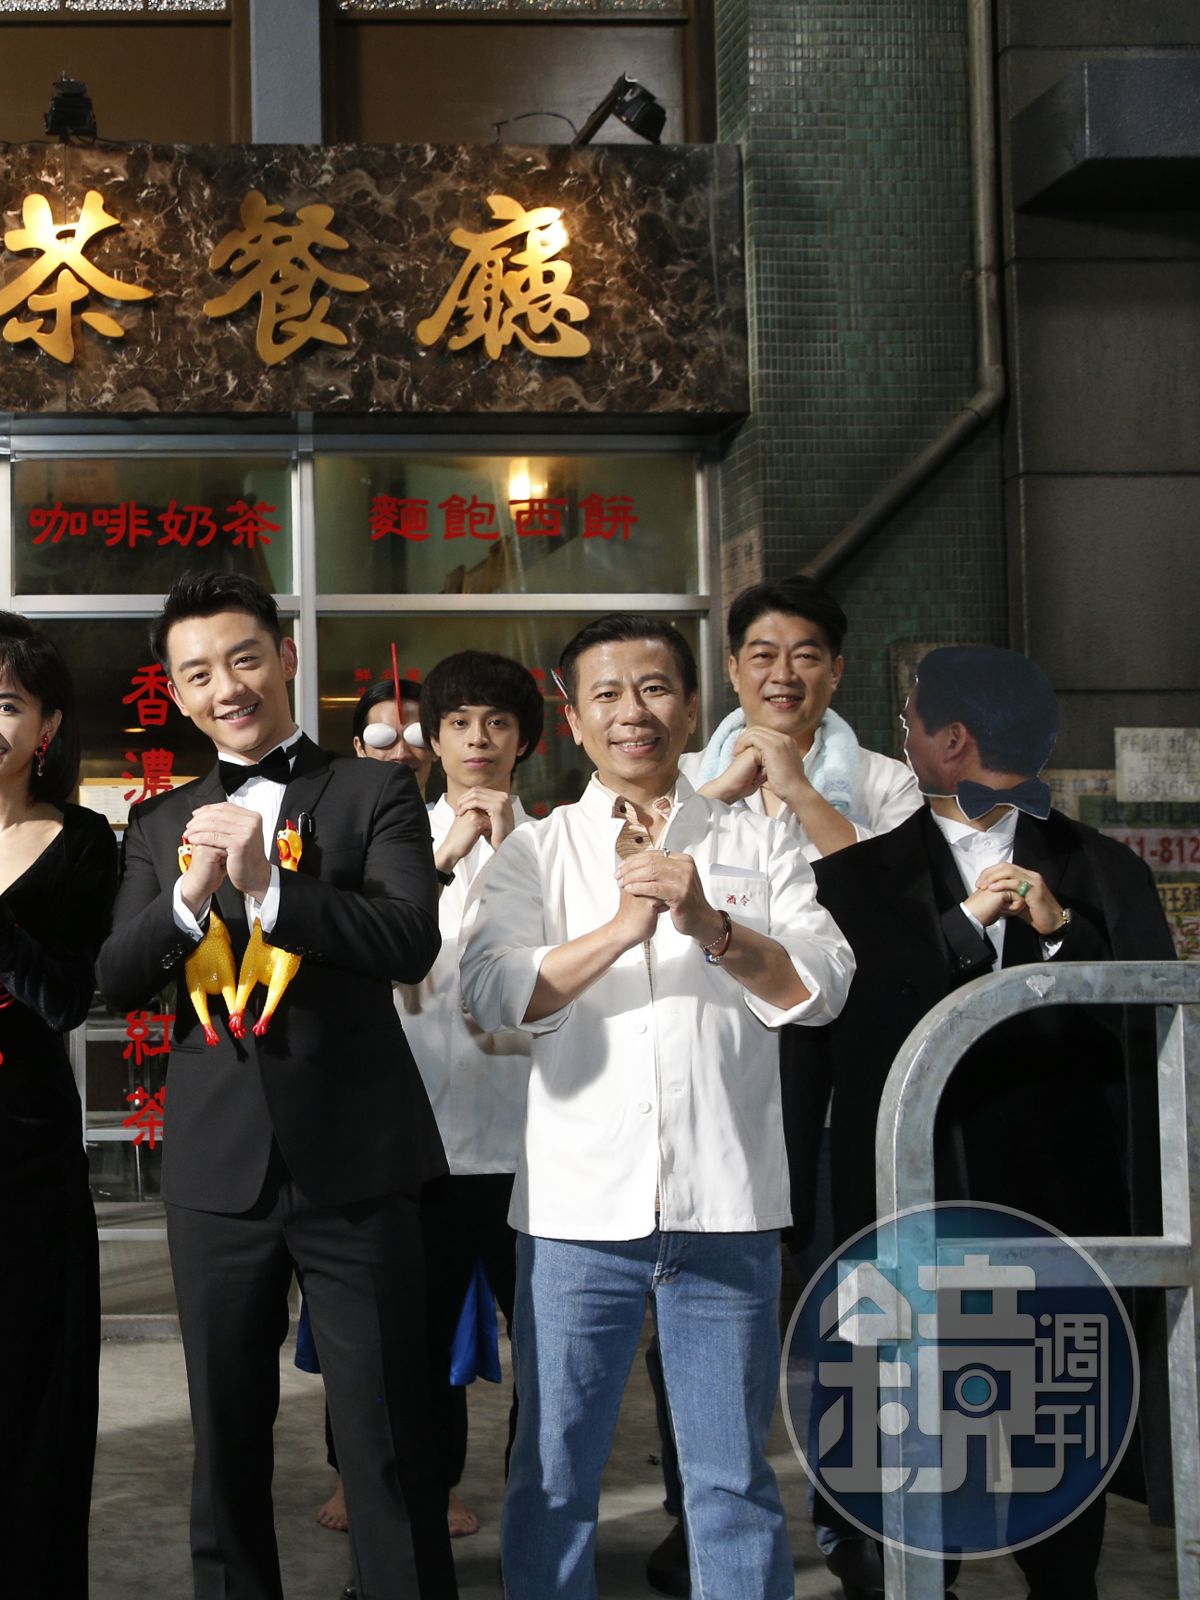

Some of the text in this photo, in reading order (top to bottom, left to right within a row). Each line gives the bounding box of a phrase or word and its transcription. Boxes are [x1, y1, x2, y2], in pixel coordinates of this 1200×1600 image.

[29, 500, 282, 549] 咖啡奶茶
[369, 493, 639, 542] 麵飽西餅
